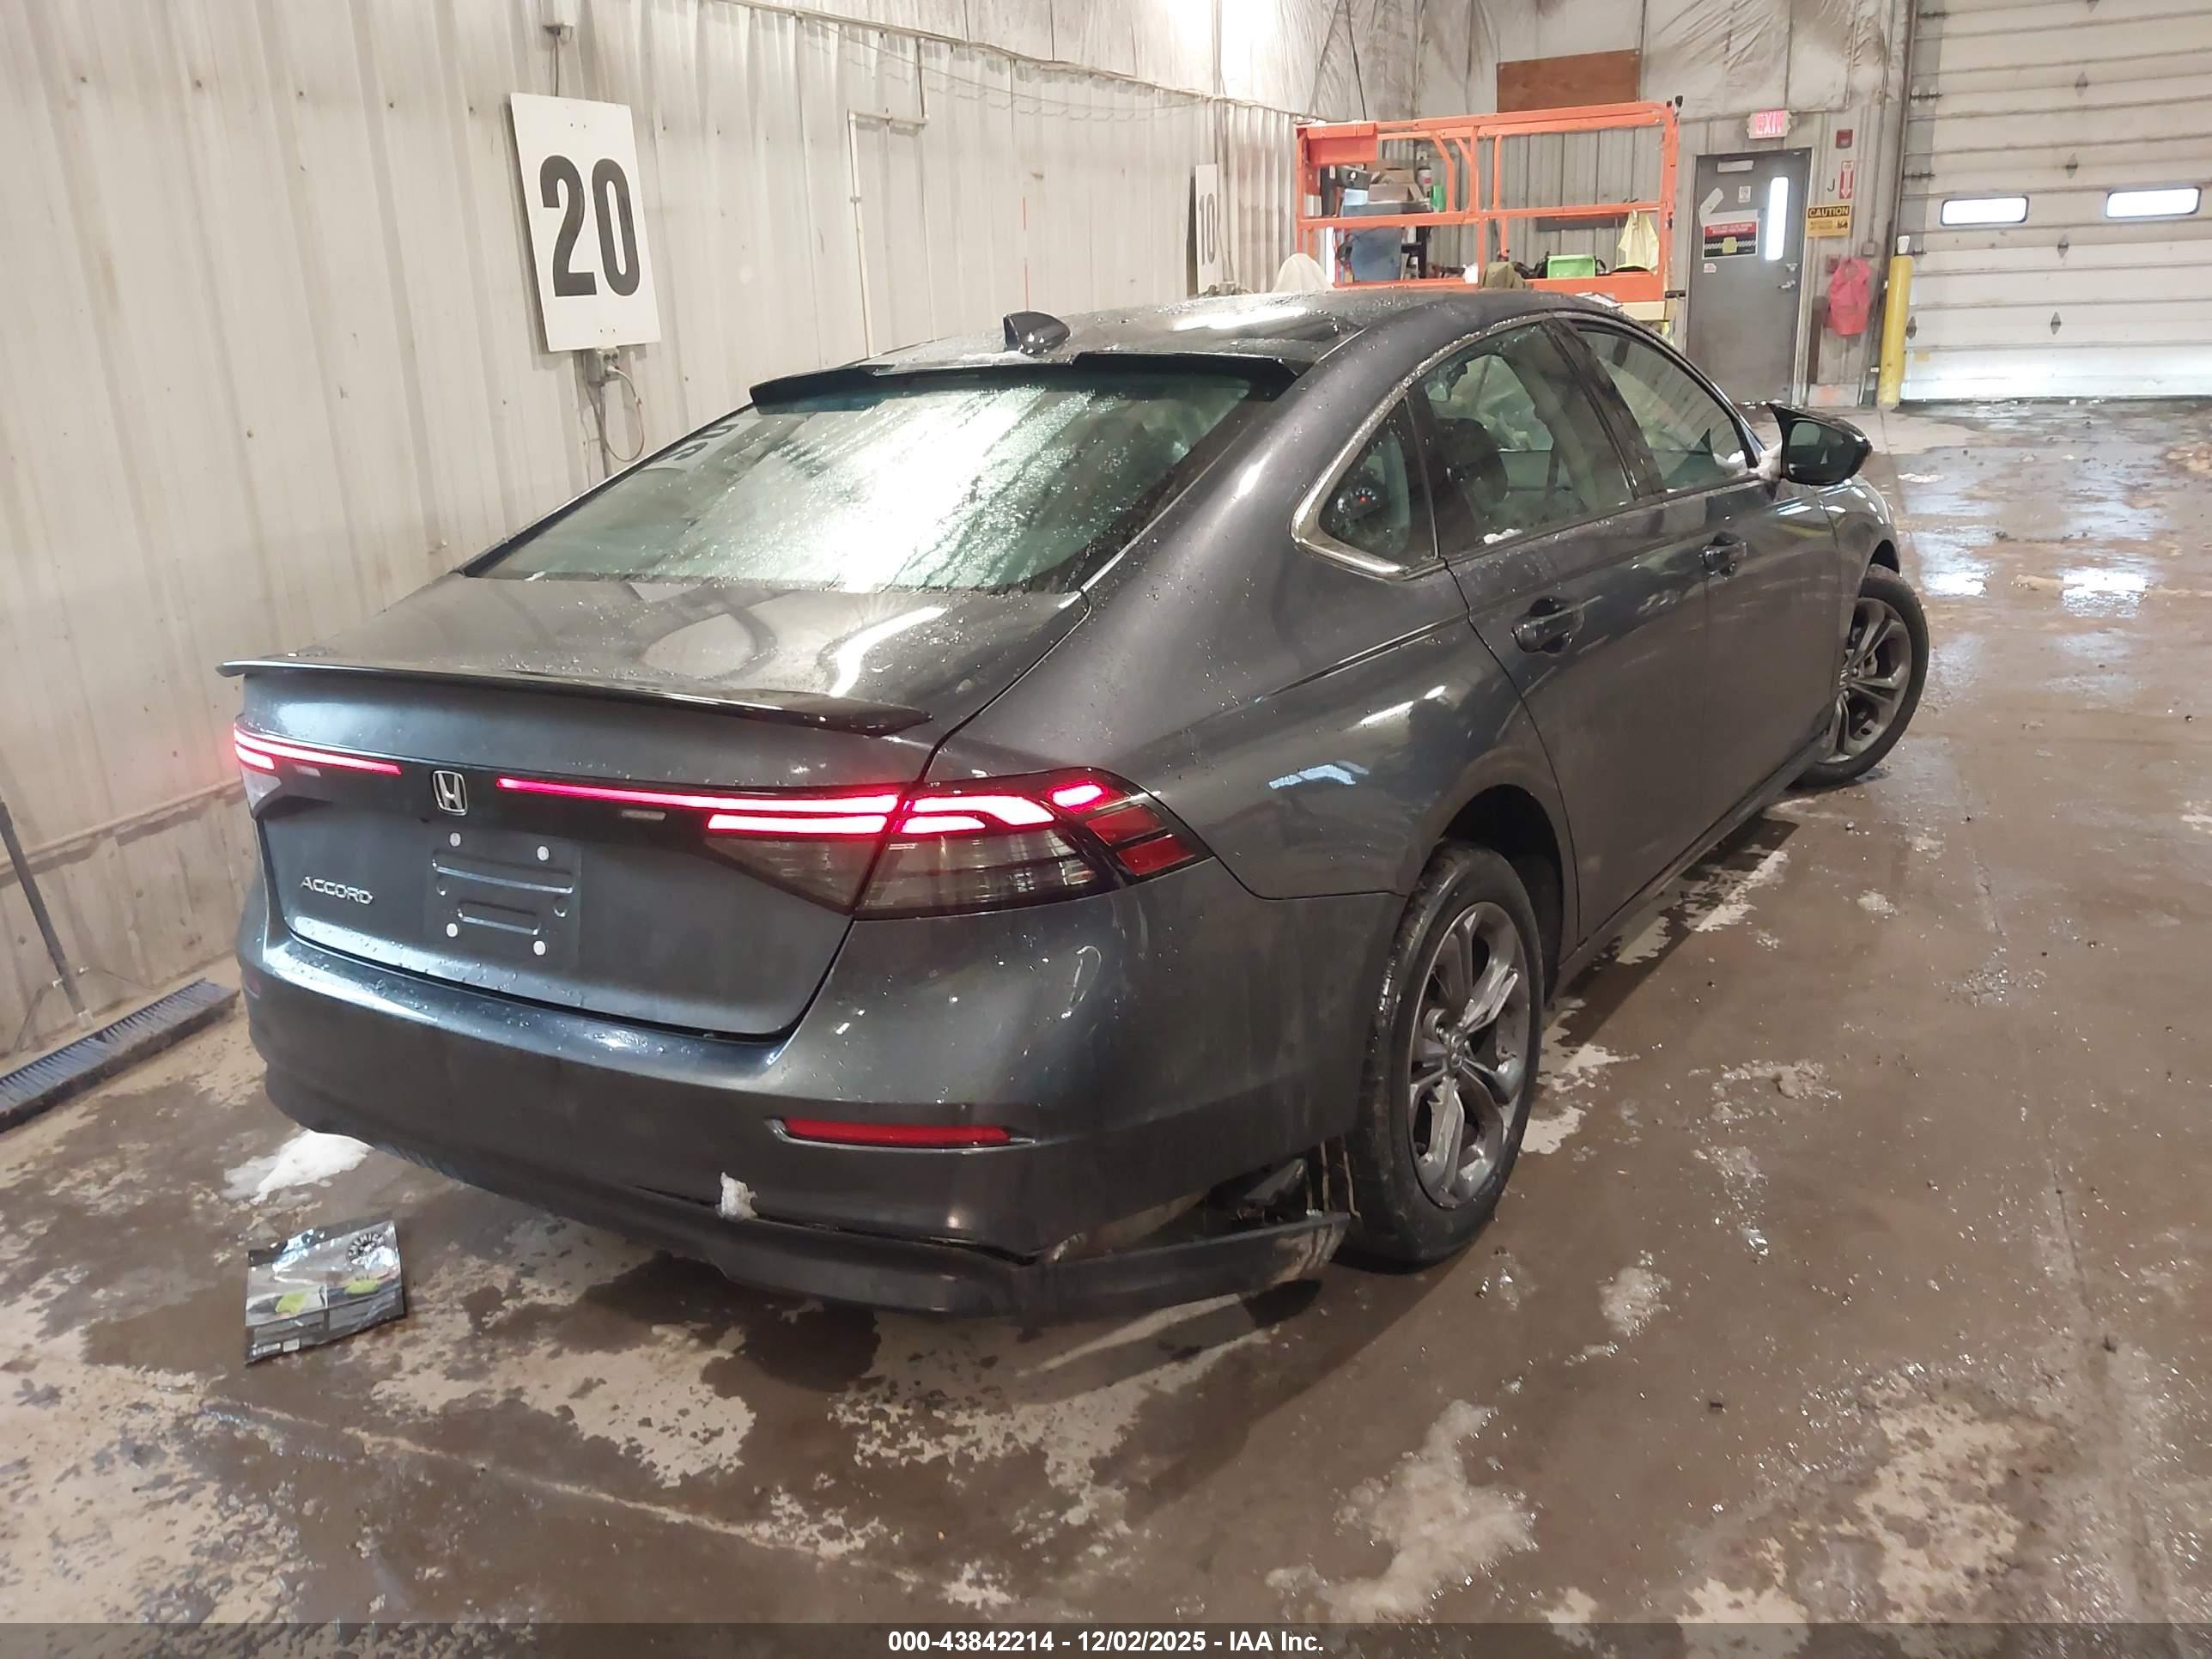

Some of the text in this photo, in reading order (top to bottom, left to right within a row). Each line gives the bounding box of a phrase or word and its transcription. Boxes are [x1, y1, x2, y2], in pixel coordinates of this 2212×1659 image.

[1755, 112, 1785, 135] EXIT
[540, 155, 641, 297] 20
[1808, 207, 1850, 217] CAUTION
[1199, 192, 1216, 265] 10
[301, 876, 374, 905] ACCORD
